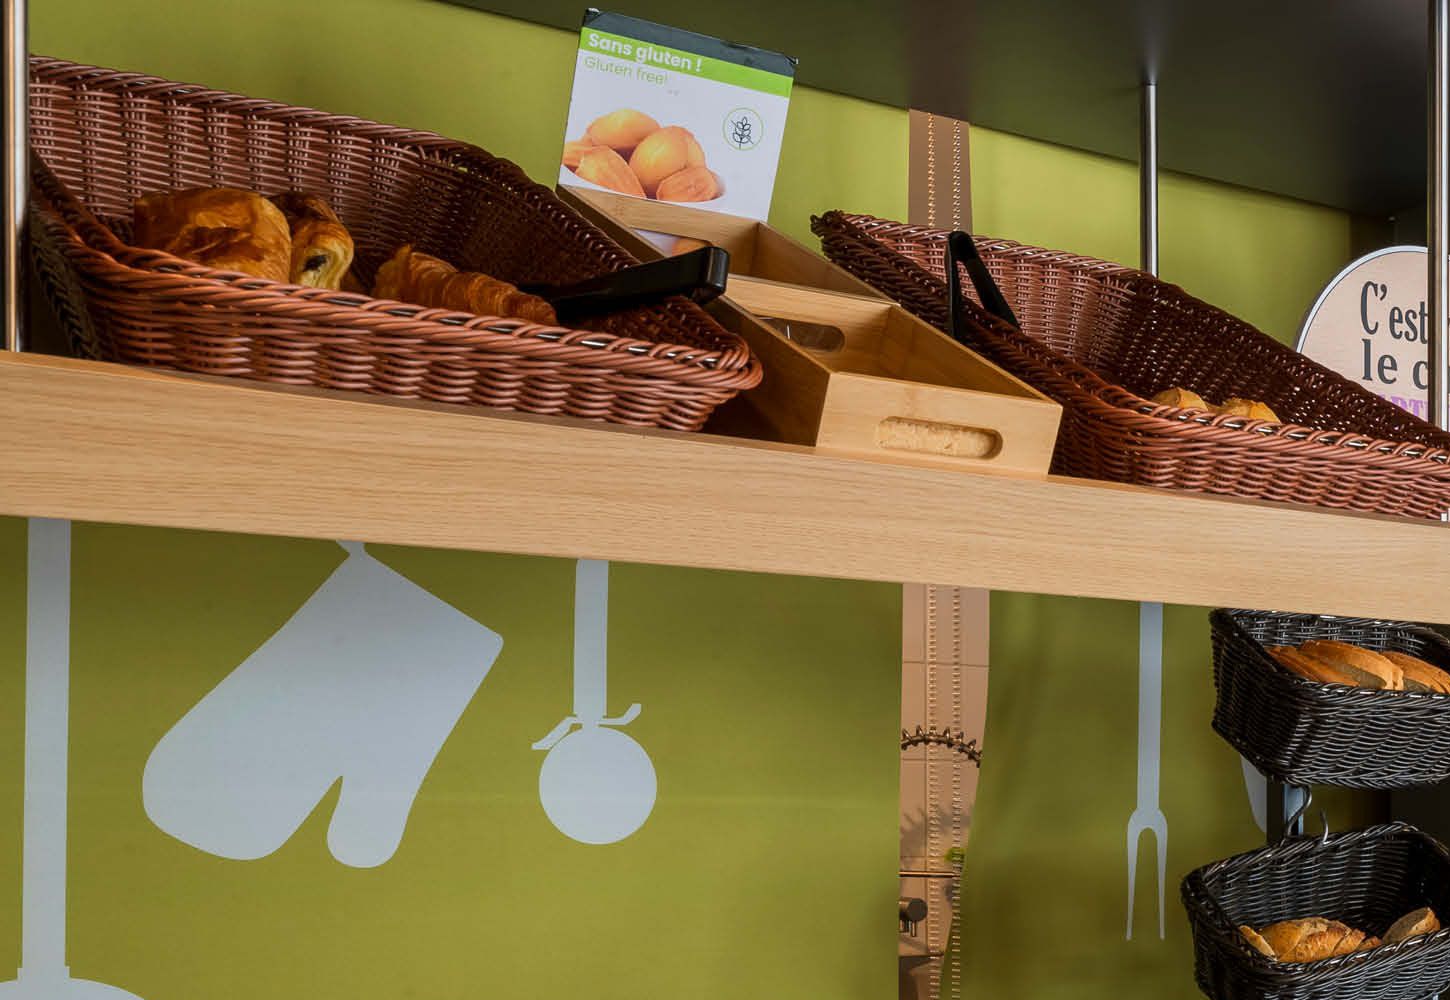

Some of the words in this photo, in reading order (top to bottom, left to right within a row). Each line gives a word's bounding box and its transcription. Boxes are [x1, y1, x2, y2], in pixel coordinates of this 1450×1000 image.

[583, 55, 633, 77] Gluten
[587, 32, 633, 56] Sans
[636, 46, 693, 71] gluten
[694, 58, 704, 73] !
[1361, 338, 1398, 385] le
